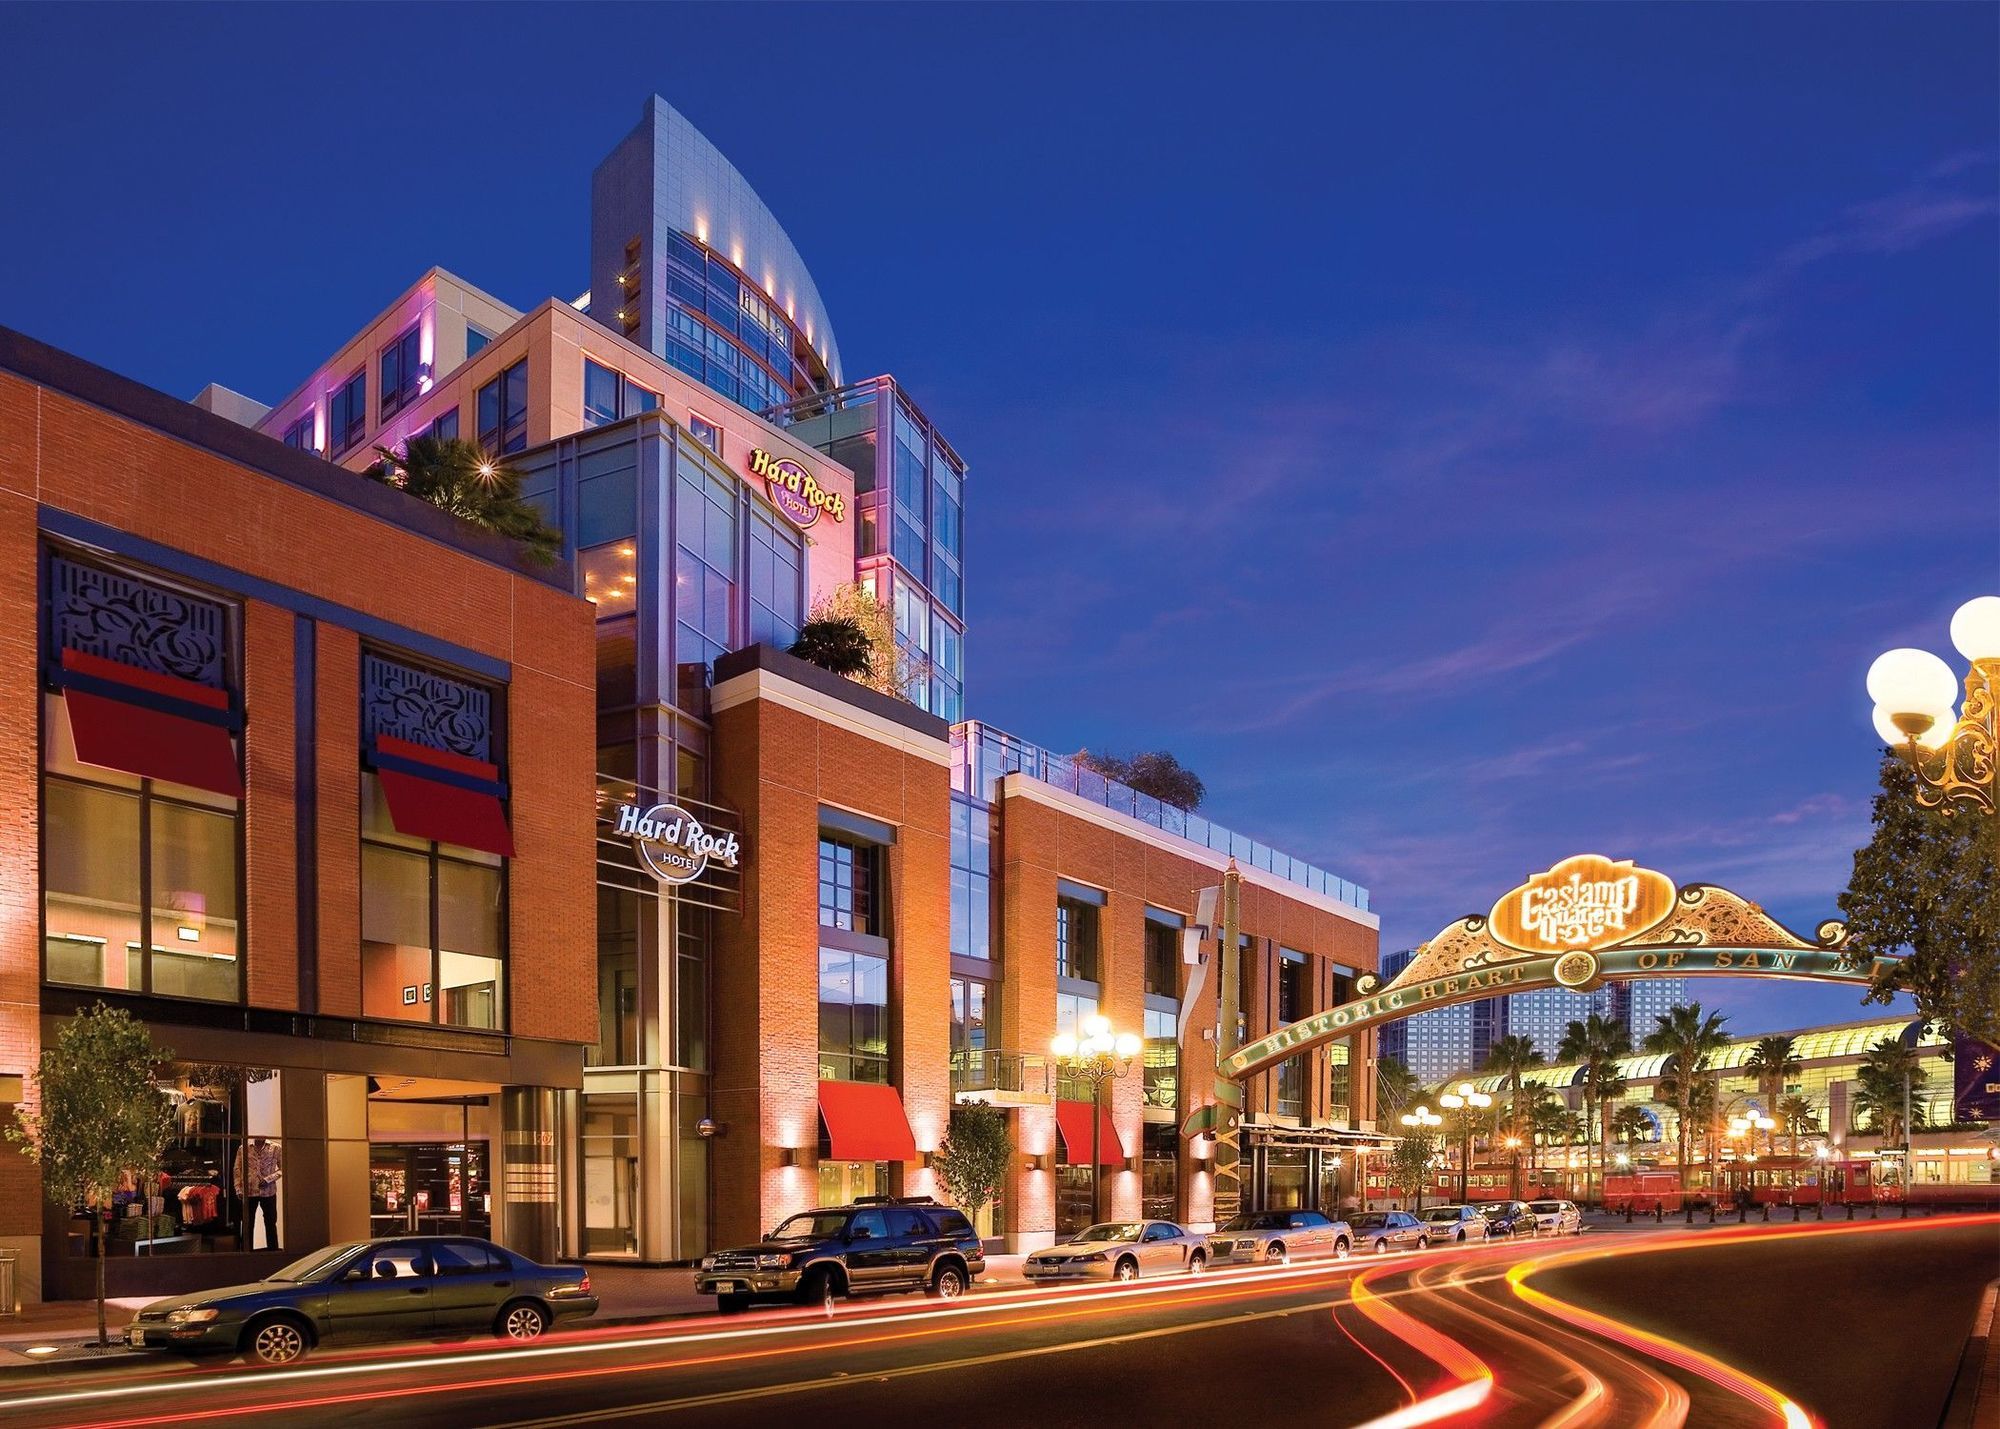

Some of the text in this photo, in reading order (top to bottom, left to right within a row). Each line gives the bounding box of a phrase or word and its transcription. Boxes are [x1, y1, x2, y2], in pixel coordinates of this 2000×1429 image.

[752, 449, 845, 522] Hard Rock
[785, 497, 812, 518] HOTEL
[619, 805, 740, 865] Hard Rock
[662, 853, 698, 871] HOTEL
[1521, 873, 1638, 930] Gaslamp
[1264, 992, 1404, 1054] HISTORIC
[1420, 966, 1525, 1000] HEART
[1638, 952, 1684, 970] OF
[1713, 951, 1797, 970] SAN
